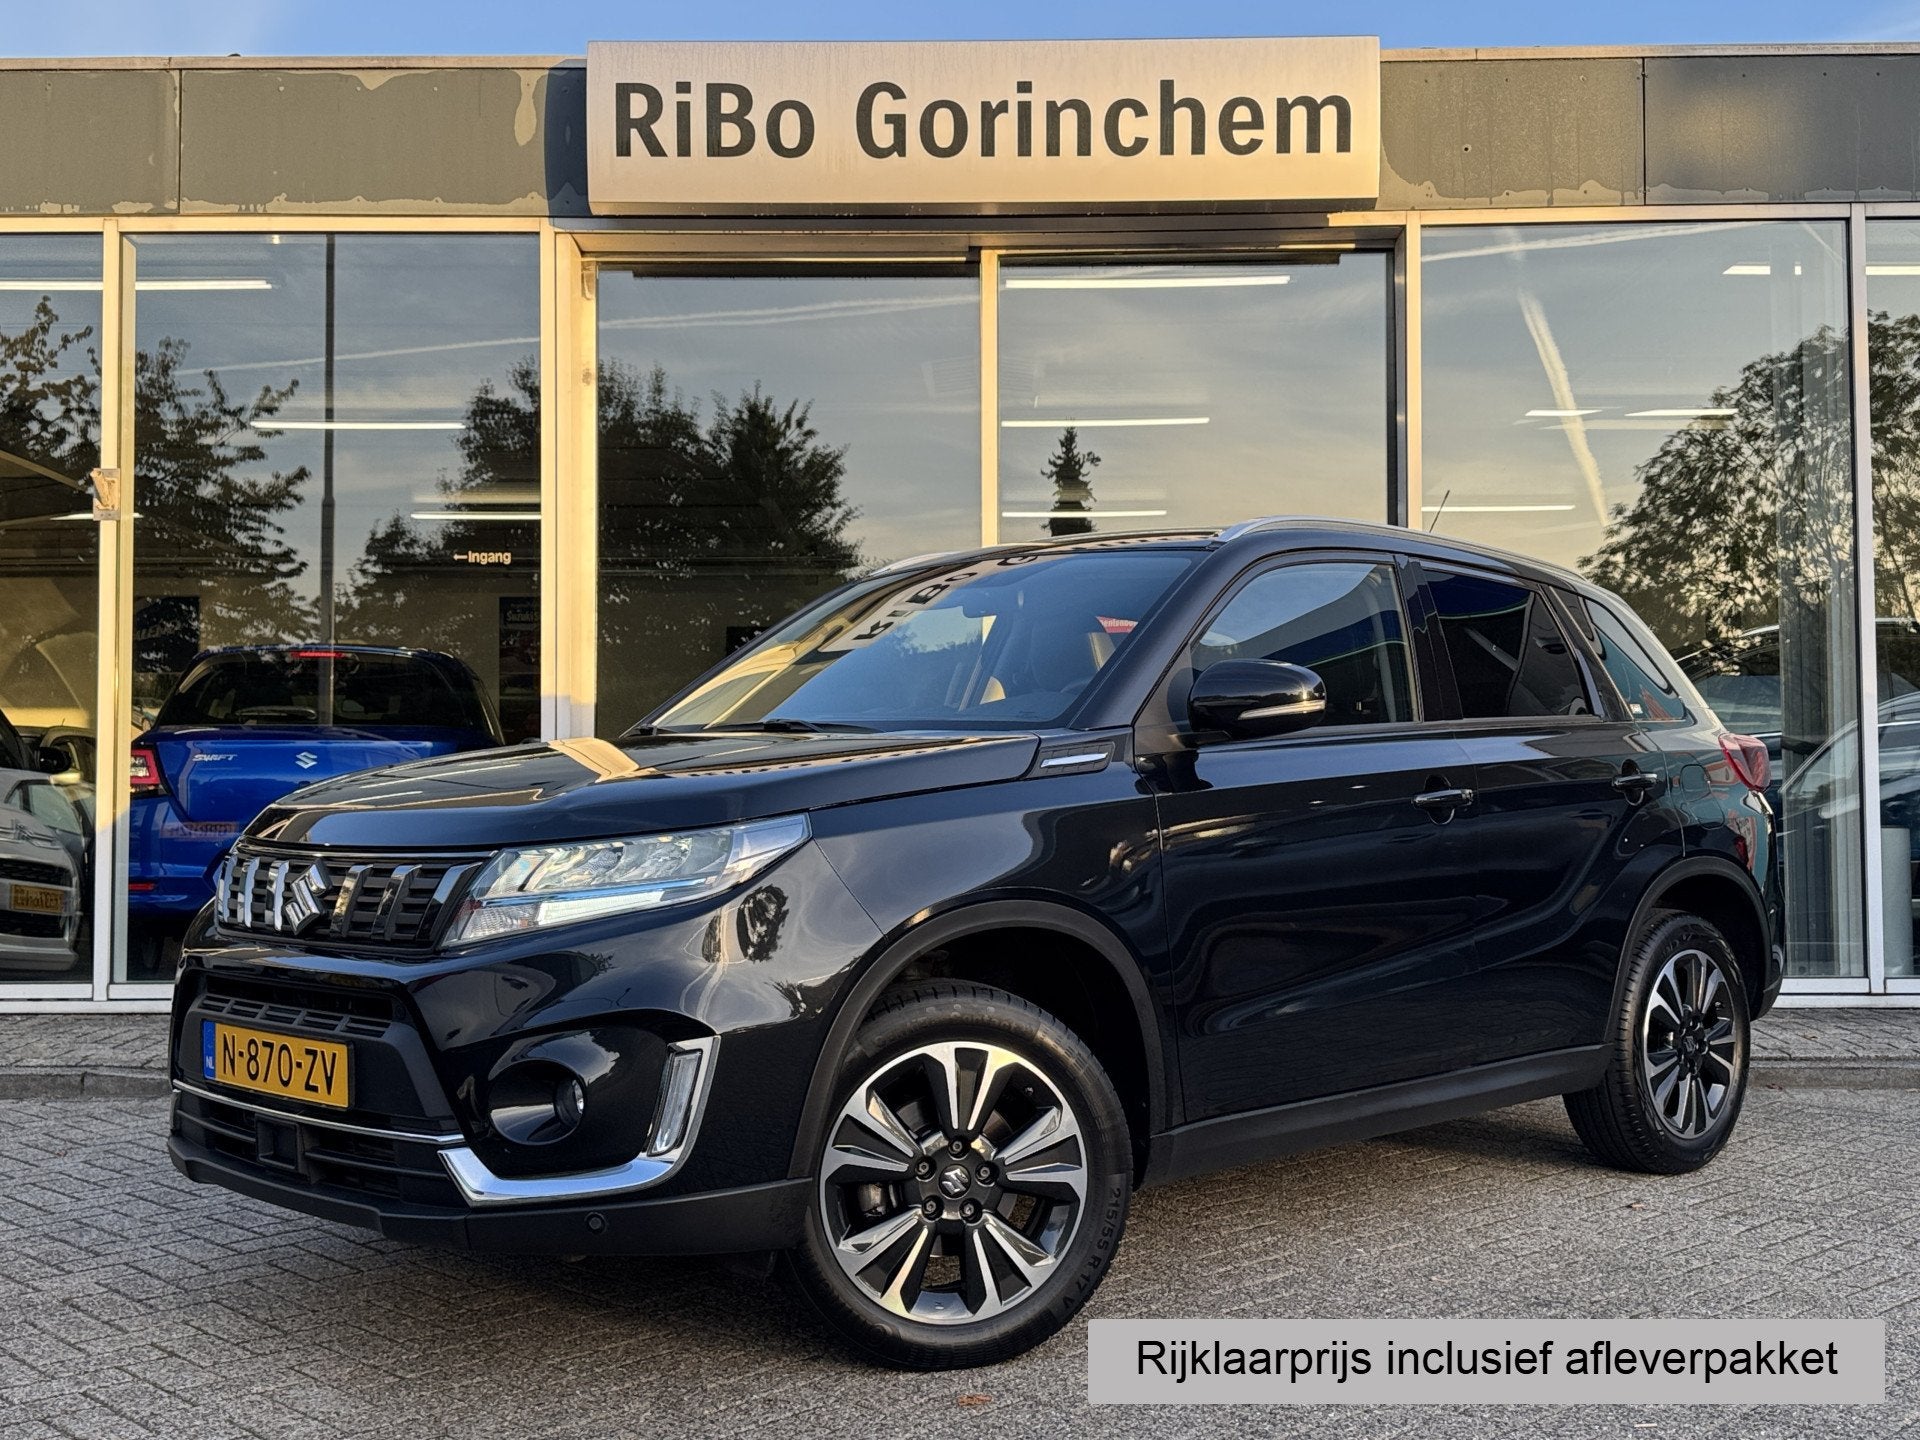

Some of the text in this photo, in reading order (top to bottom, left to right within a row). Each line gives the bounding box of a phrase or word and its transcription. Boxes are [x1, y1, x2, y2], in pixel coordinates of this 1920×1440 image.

[614, 78, 1352, 160] RiBo Gorinchem
[468, 550, 512, 565] Ingang
[192, 753, 237, 762] SWIFT
[205, 1055, 215, 1070] NL
[222, 1032, 338, 1096] N-870-ZV
[1095, 1187, 1122, 1252] 215/55
